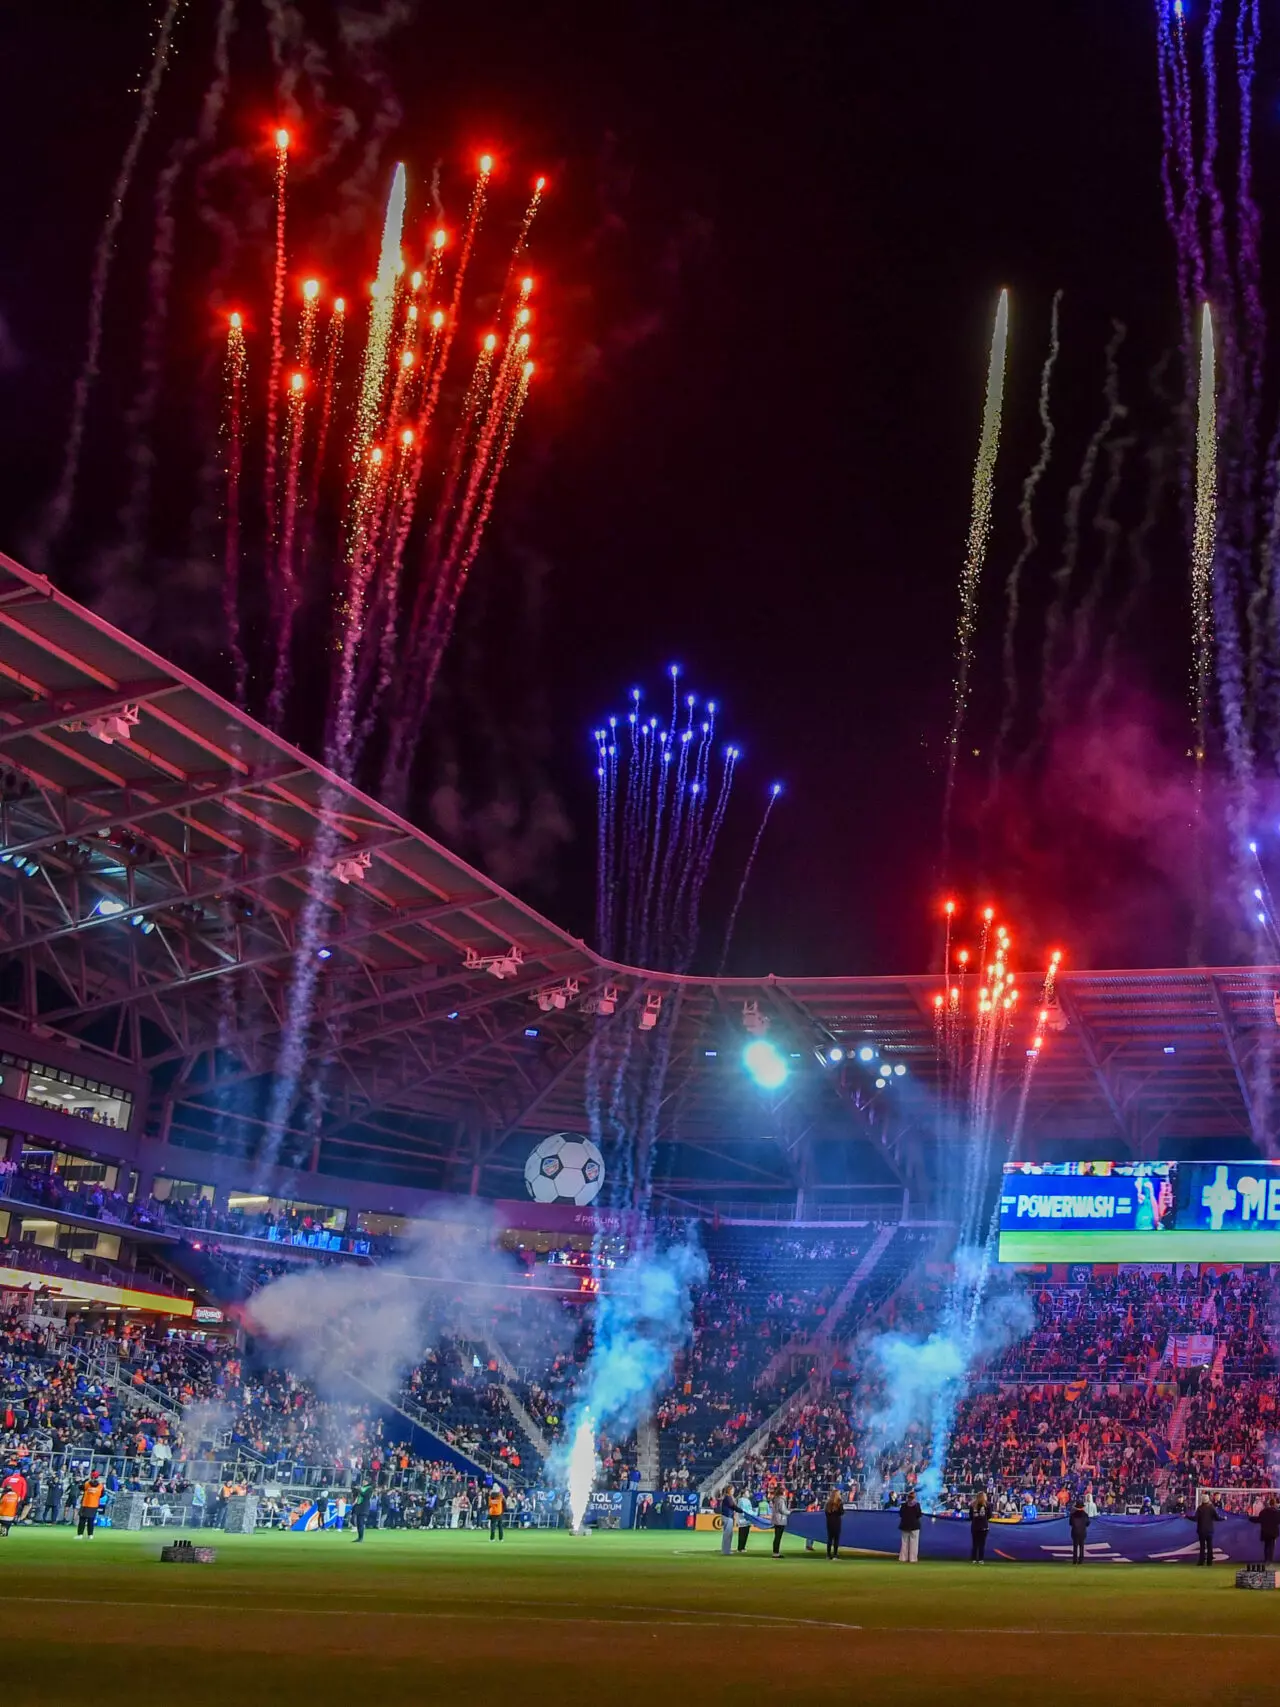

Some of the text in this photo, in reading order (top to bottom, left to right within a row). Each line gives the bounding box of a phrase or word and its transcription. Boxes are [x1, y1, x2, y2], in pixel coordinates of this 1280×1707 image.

[1017, 1194, 1115, 1218] POWERWASH
[592, 1493, 612, 1503] TQL
[667, 1494, 688, 1504] TQL
[590, 1503, 622, 1511] STADIUM
